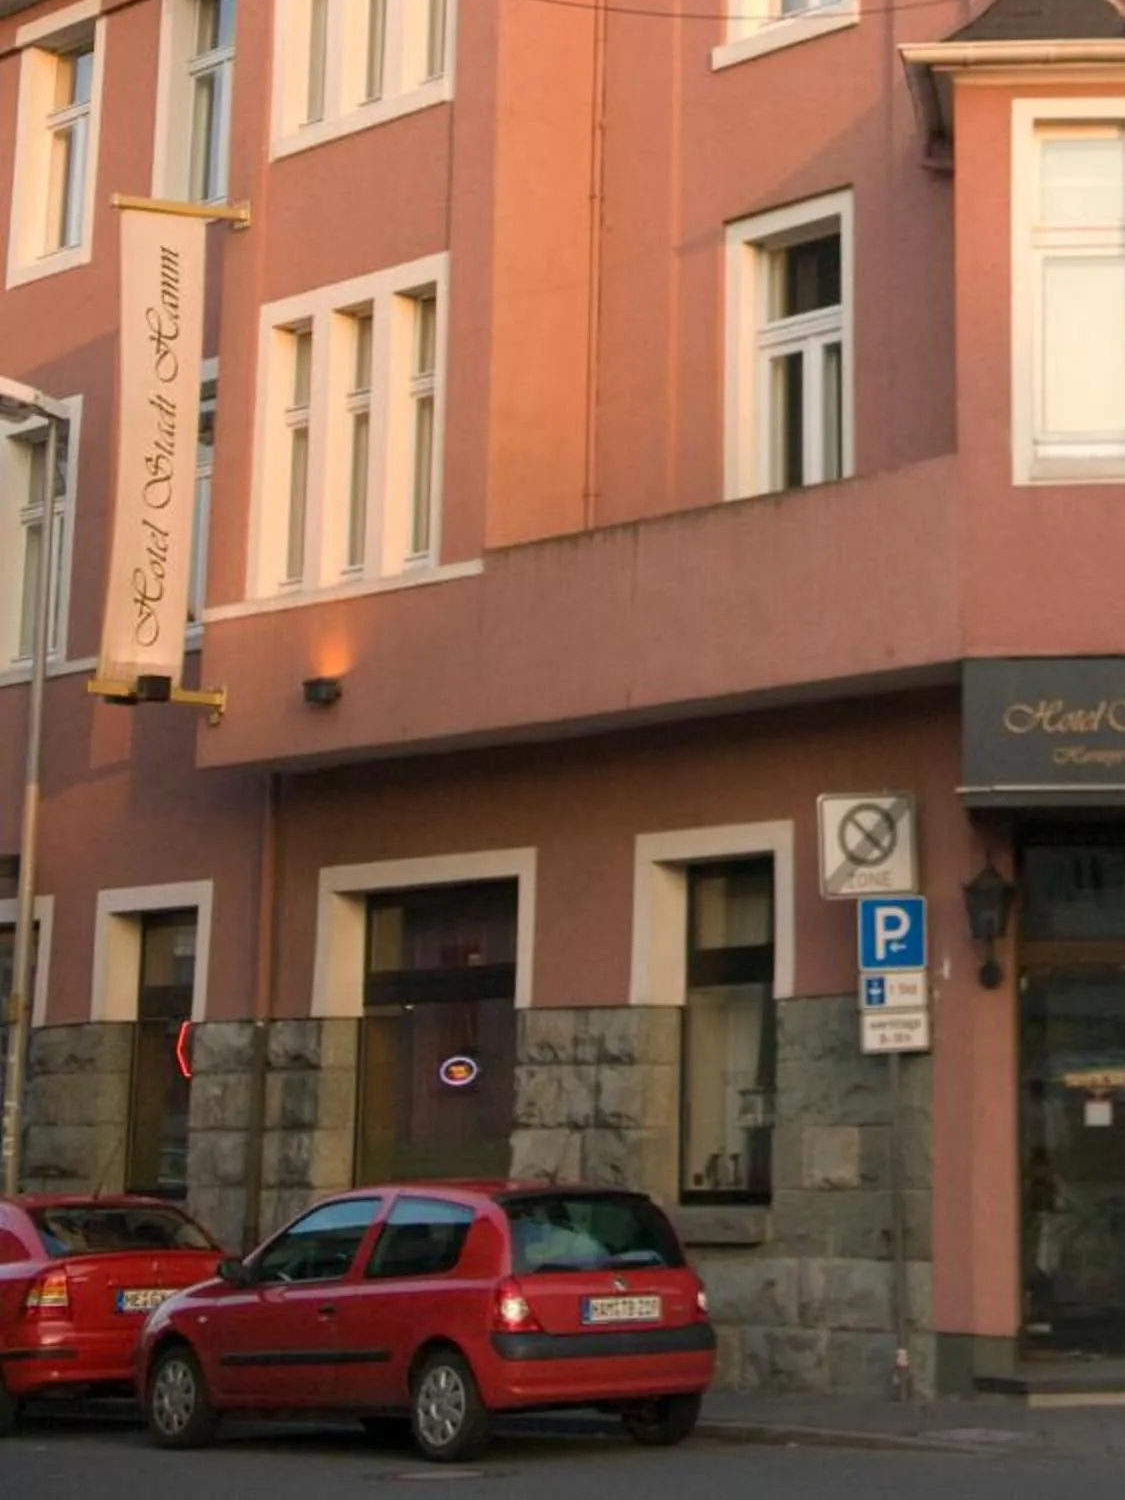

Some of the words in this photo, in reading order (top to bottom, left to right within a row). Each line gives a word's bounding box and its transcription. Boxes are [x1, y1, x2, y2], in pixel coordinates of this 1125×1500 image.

[146, 245, 181, 384] Hamm
[143, 393, 178, 510] Stadt
[135, 518, 170, 648] Hotel
[1003, 698, 1106, 734] Hotel
[848, 869, 892, 888] ZONE
[874, 906, 912, 961] P
